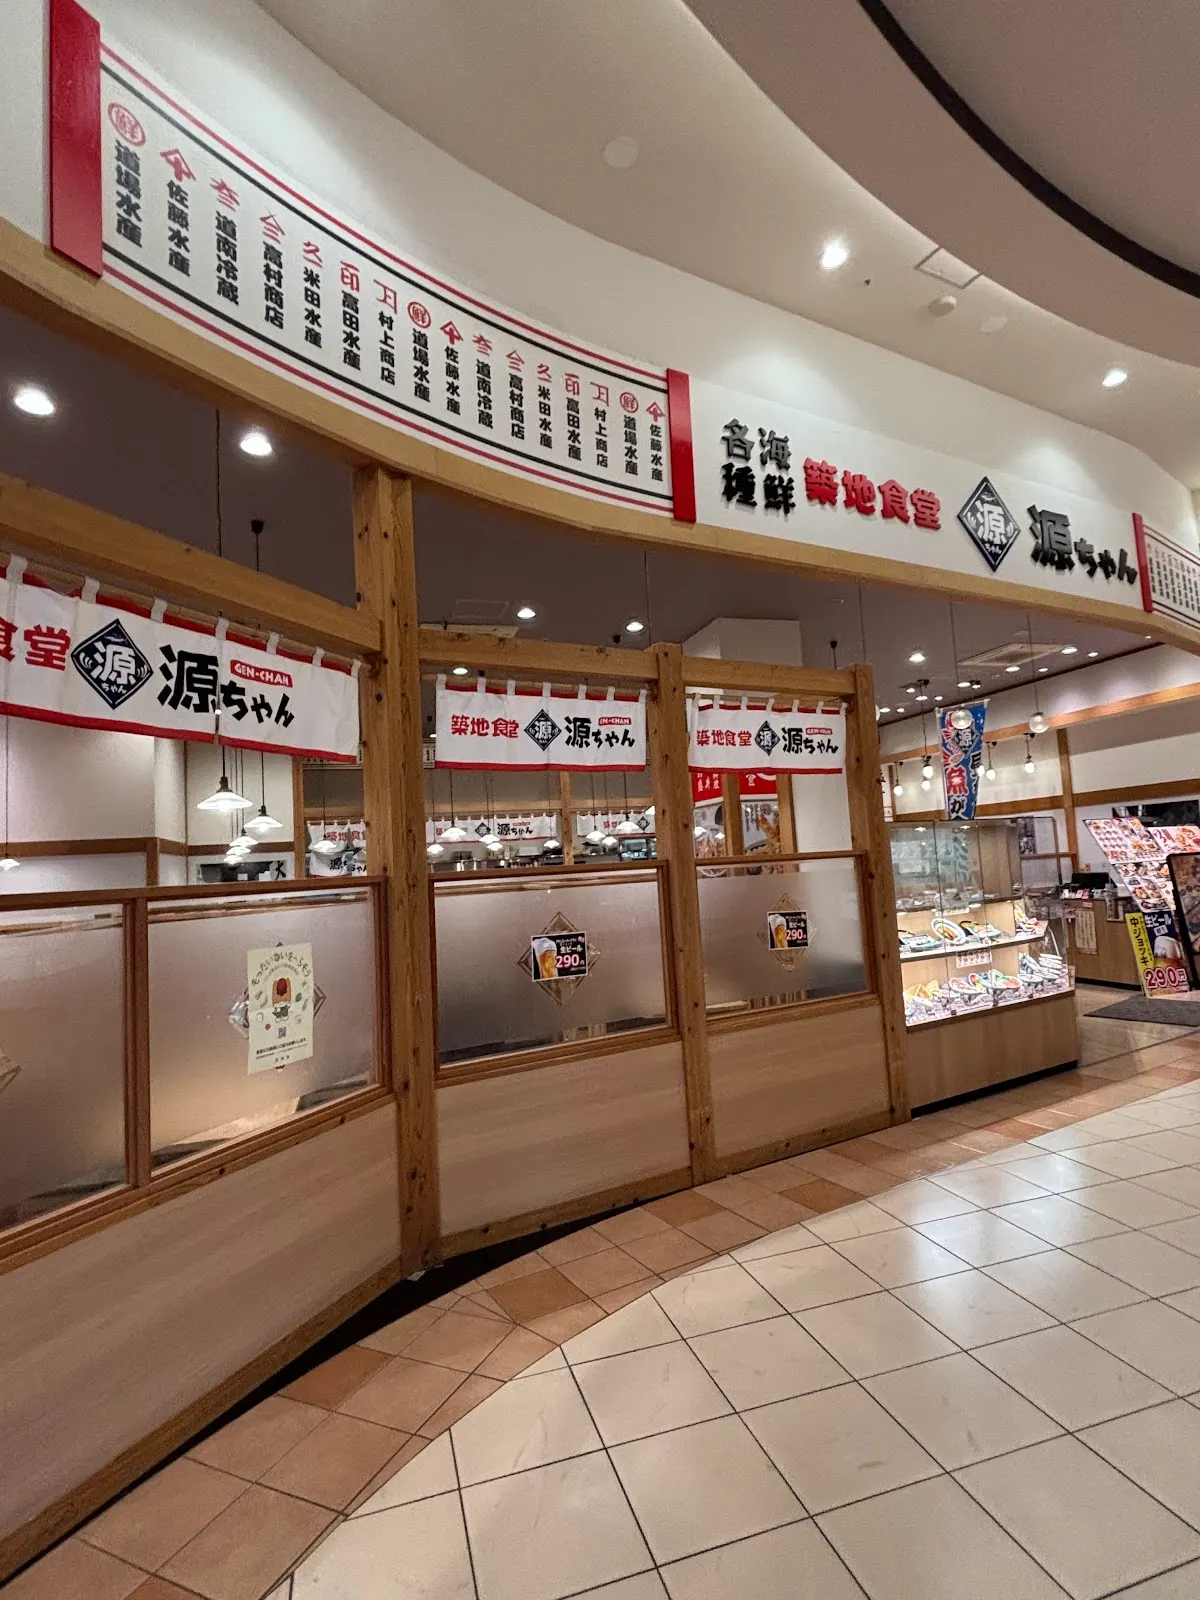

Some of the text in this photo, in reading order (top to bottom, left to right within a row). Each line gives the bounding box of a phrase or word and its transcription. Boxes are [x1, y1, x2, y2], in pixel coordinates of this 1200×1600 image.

[115, 140, 143, 248] 道場水産
[166, 179, 191, 277] 佐藤水産
[263, 241, 284, 330] 高村商店
[303, 266, 323, 349] 米田水産
[341, 290, 361, 371] 高田水産
[378, 311, 396, 386] 村上商店
[412, 328, 430, 402] 道場水産
[444, 346, 461, 415] 佐藤水産
[476, 359, 493, 429] 道南冷蔵
[509, 373, 525, 440] 高村商店
[537, 385, 553, 449] 米田水産
[566, 397, 582, 461] 高田水産
[594, 407, 608, 468] 村上商店
[623, 414, 638, 476] 道場水産
[649, 423, 664, 483] 佐藤水産
[803, 457, 941, 530] 築地食堂
[977, 500, 1007, 545] 源
[1027, 504, 1138, 585] 源ちゃん
[90, 641, 136, 685] 源
[157, 644, 295, 728] 源ちゃん
[234, 663, 290, 686] GEN-CHAN
[565, 716, 635, 748] 源ちゃん
[696, 729, 752, 747] 築地食堂
[781, 727, 839, 755] 源ちゃん
